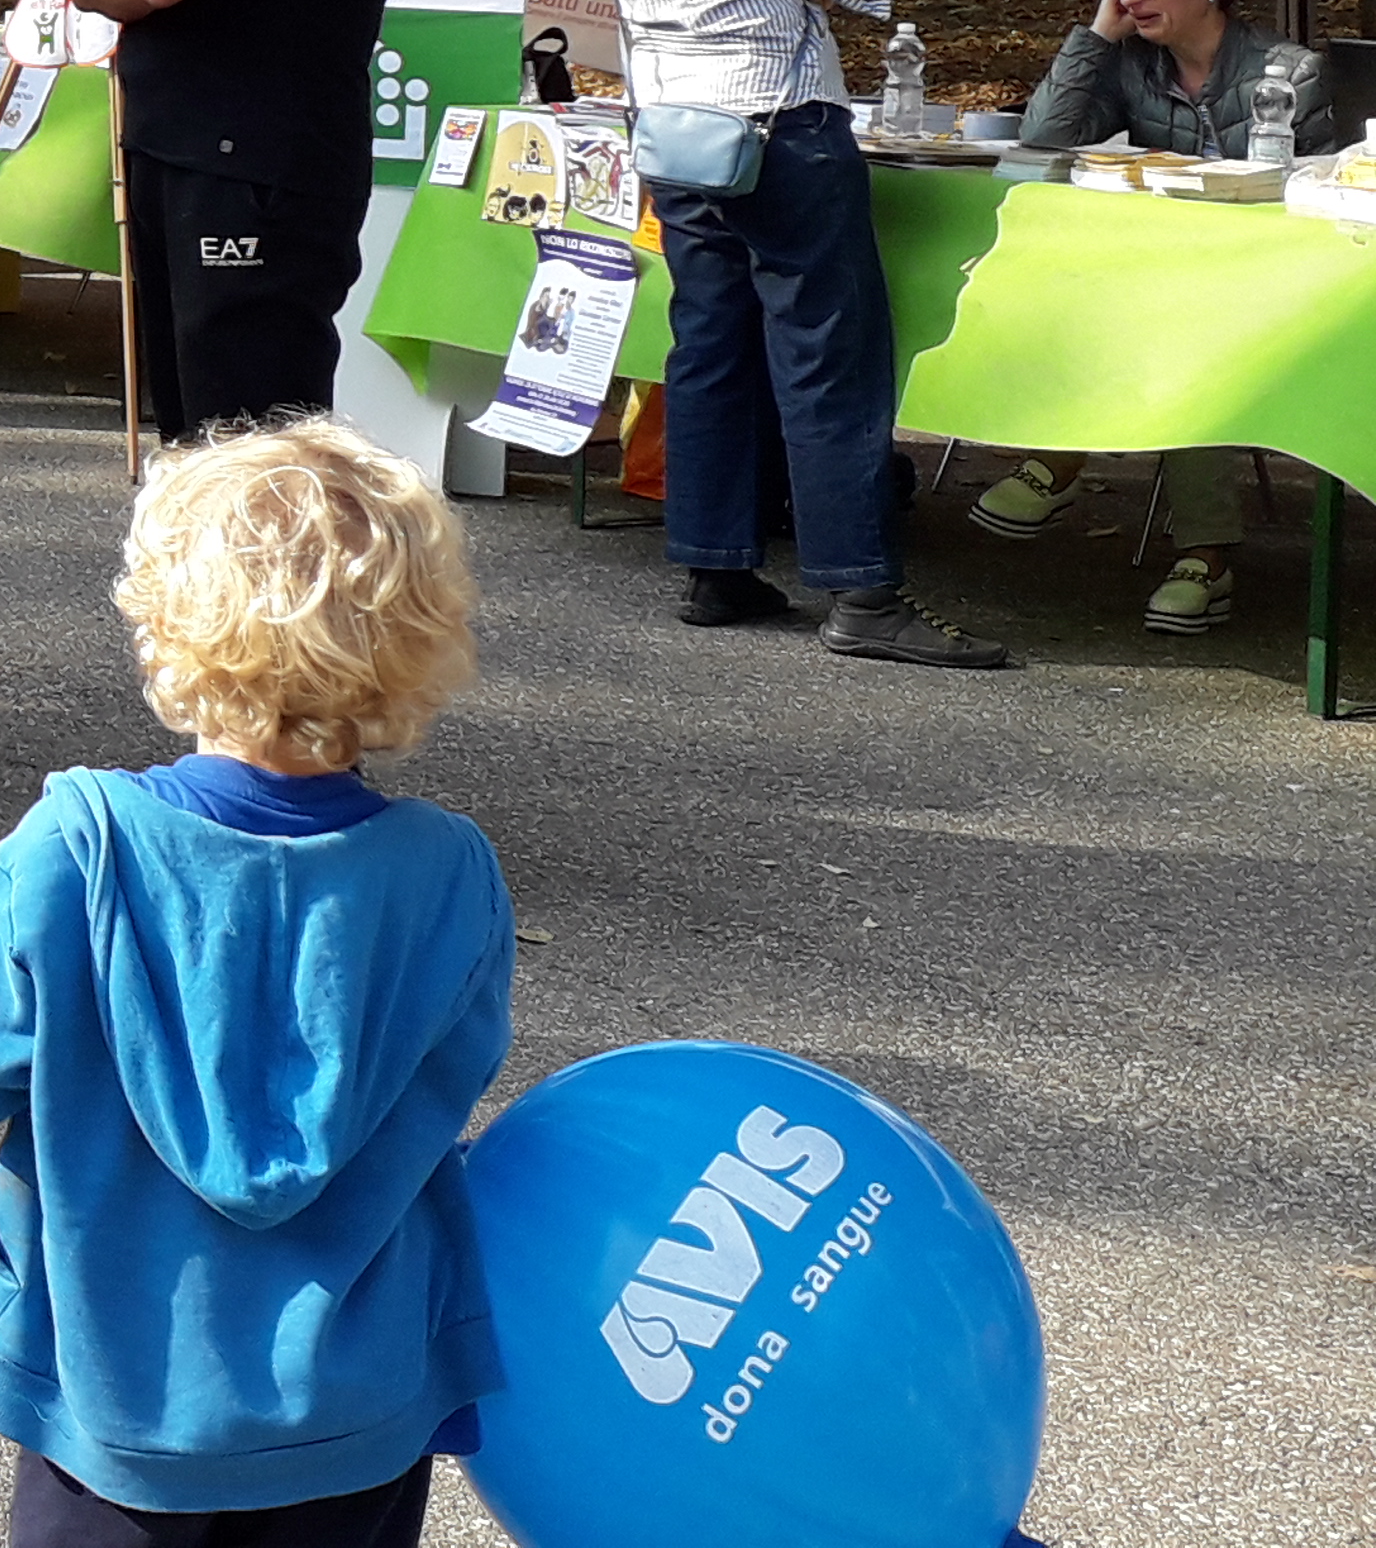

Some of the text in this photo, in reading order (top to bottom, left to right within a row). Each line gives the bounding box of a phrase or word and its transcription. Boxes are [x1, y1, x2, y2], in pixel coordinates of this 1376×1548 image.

[199, 236, 260, 260] EA7
[599, 1104, 846, 1405] AVIS
[700, 1180, 895, 1444] dona sangue
